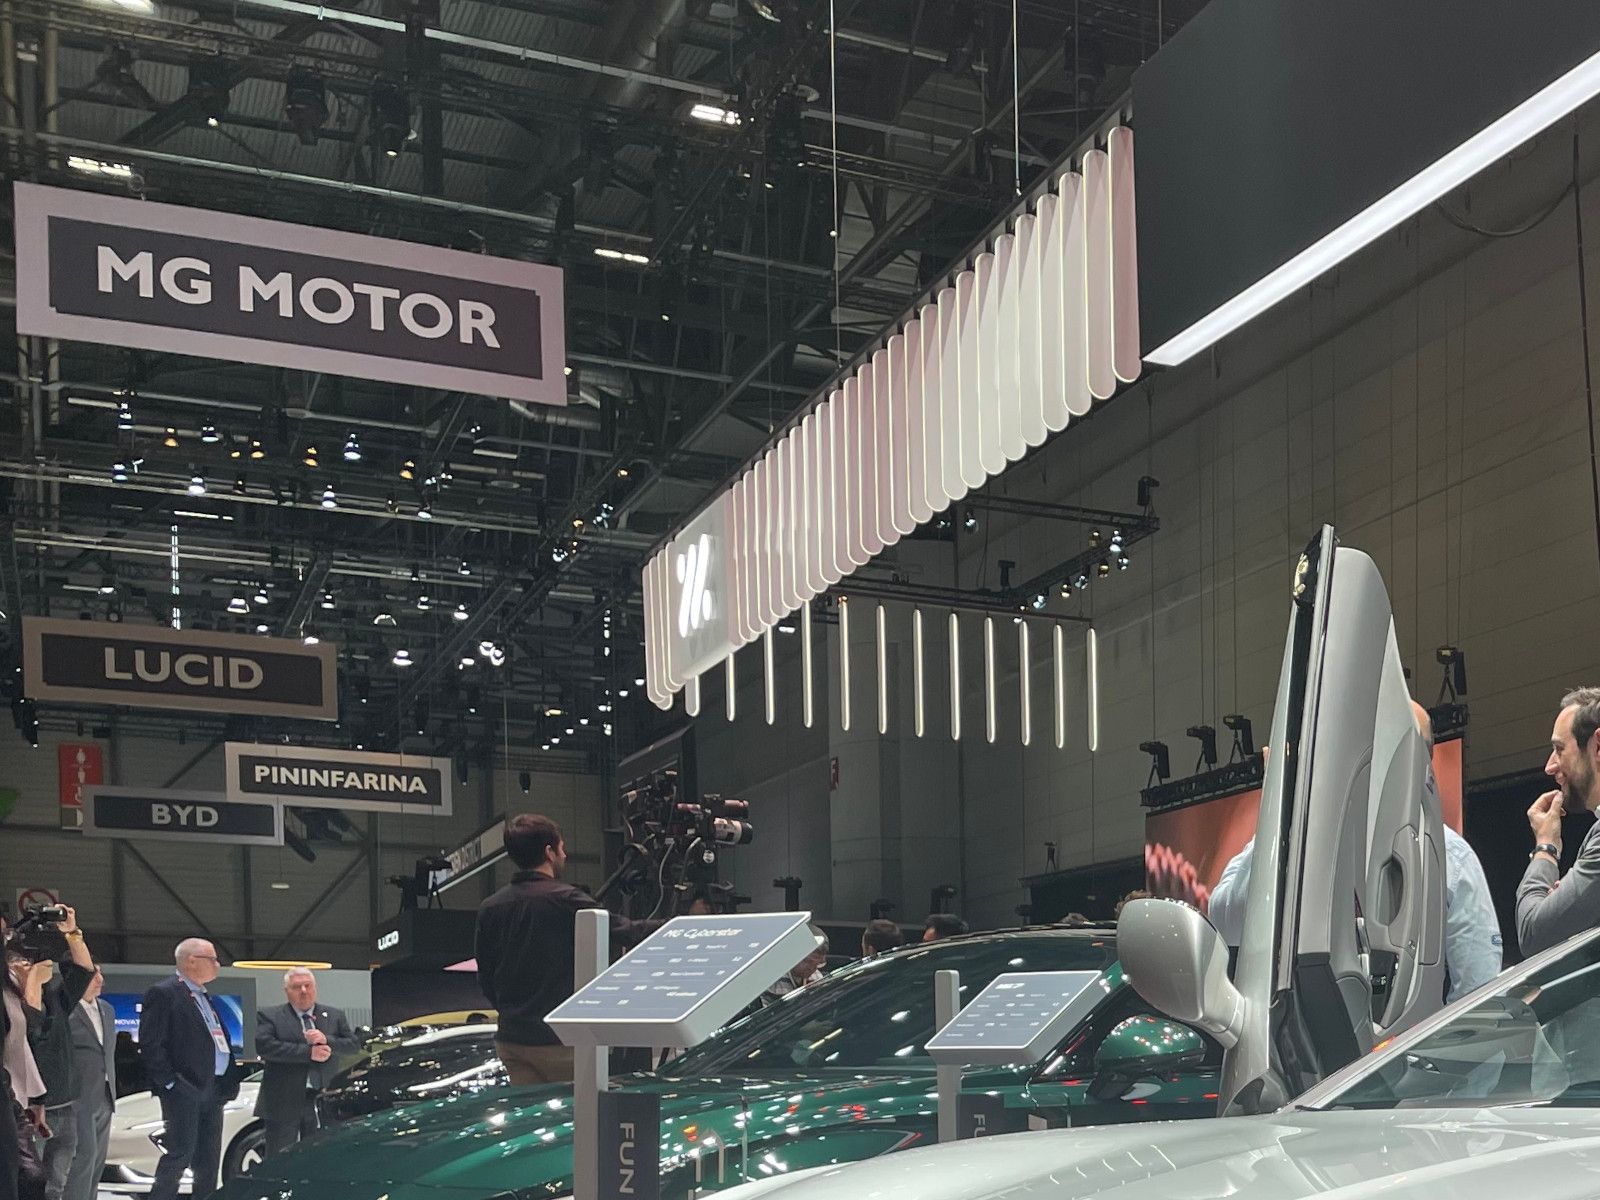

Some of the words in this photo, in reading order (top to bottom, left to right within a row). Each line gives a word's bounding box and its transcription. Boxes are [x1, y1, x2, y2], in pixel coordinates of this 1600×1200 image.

[97, 245, 213, 305] MG
[238, 265, 501, 349] MOTOR
[103, 646, 265, 690] LUCID
[254, 764, 428, 795] PININFARINA
[151, 803, 219, 827] BYD
[619, 1122, 635, 1194] FUN
